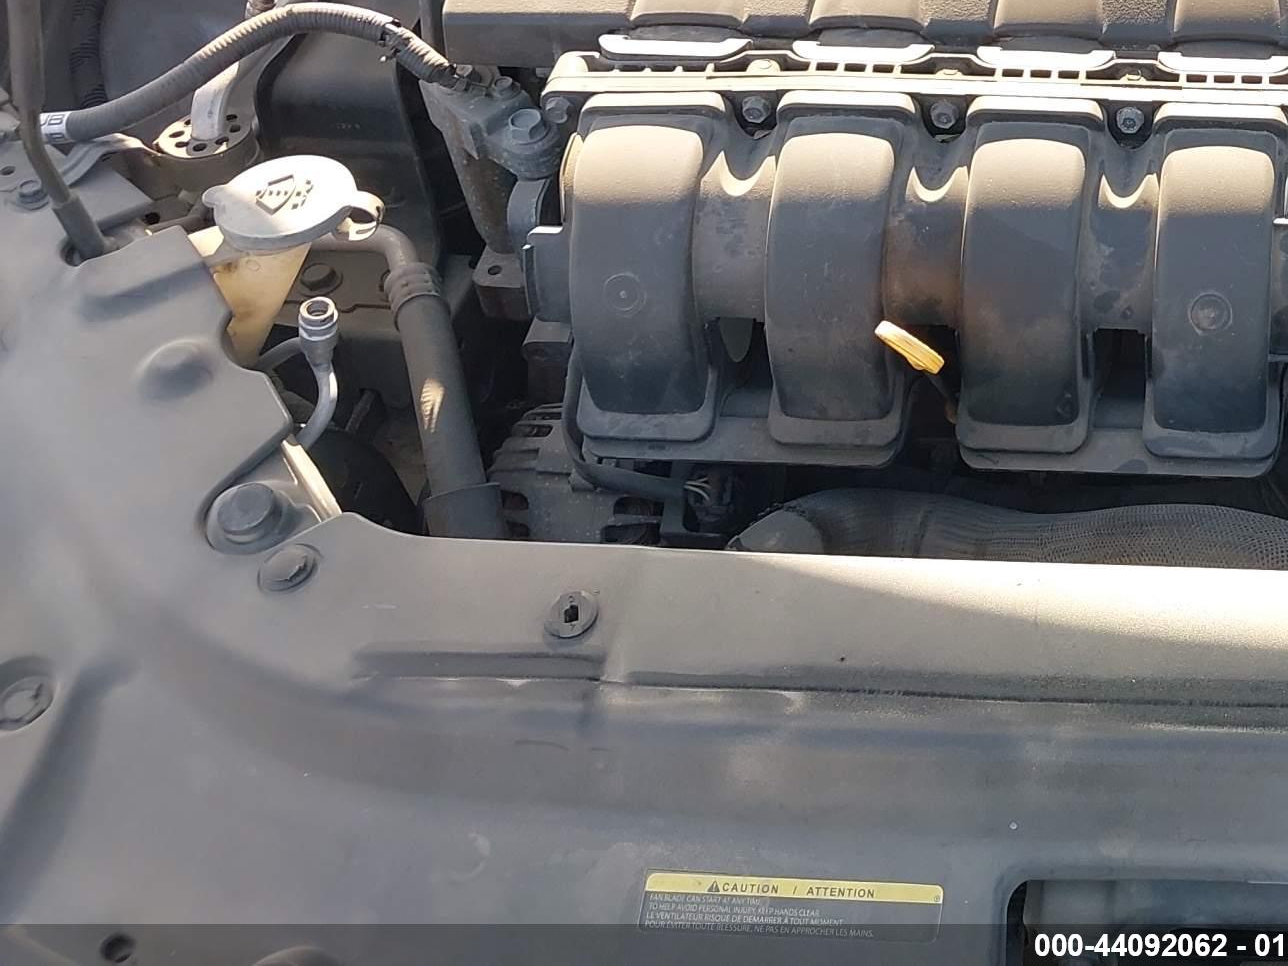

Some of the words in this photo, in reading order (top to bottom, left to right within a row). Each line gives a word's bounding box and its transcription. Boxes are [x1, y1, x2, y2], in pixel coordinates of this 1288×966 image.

[722, 882, 779, 893] CAUTION
[793, 885, 797, 895] /
[806, 886, 875, 898] ATTENTION
[649, 902, 658, 910] TO
[699, 904, 731, 914] PERSONAL
[774, 907, 798, 916] HANDS
[646, 911, 655, 919] LE
[656, 912, 703, 922] VENTILATEUR
[704, 913, 730, 922] RISQUE
[731, 914, 741, 923] DE
[789, 917, 809, 925] TOUT
[765, 925, 778, 934] PAS
[780, 926, 790, 934] EN
[791, 926, 835, 936] APPROCHER
